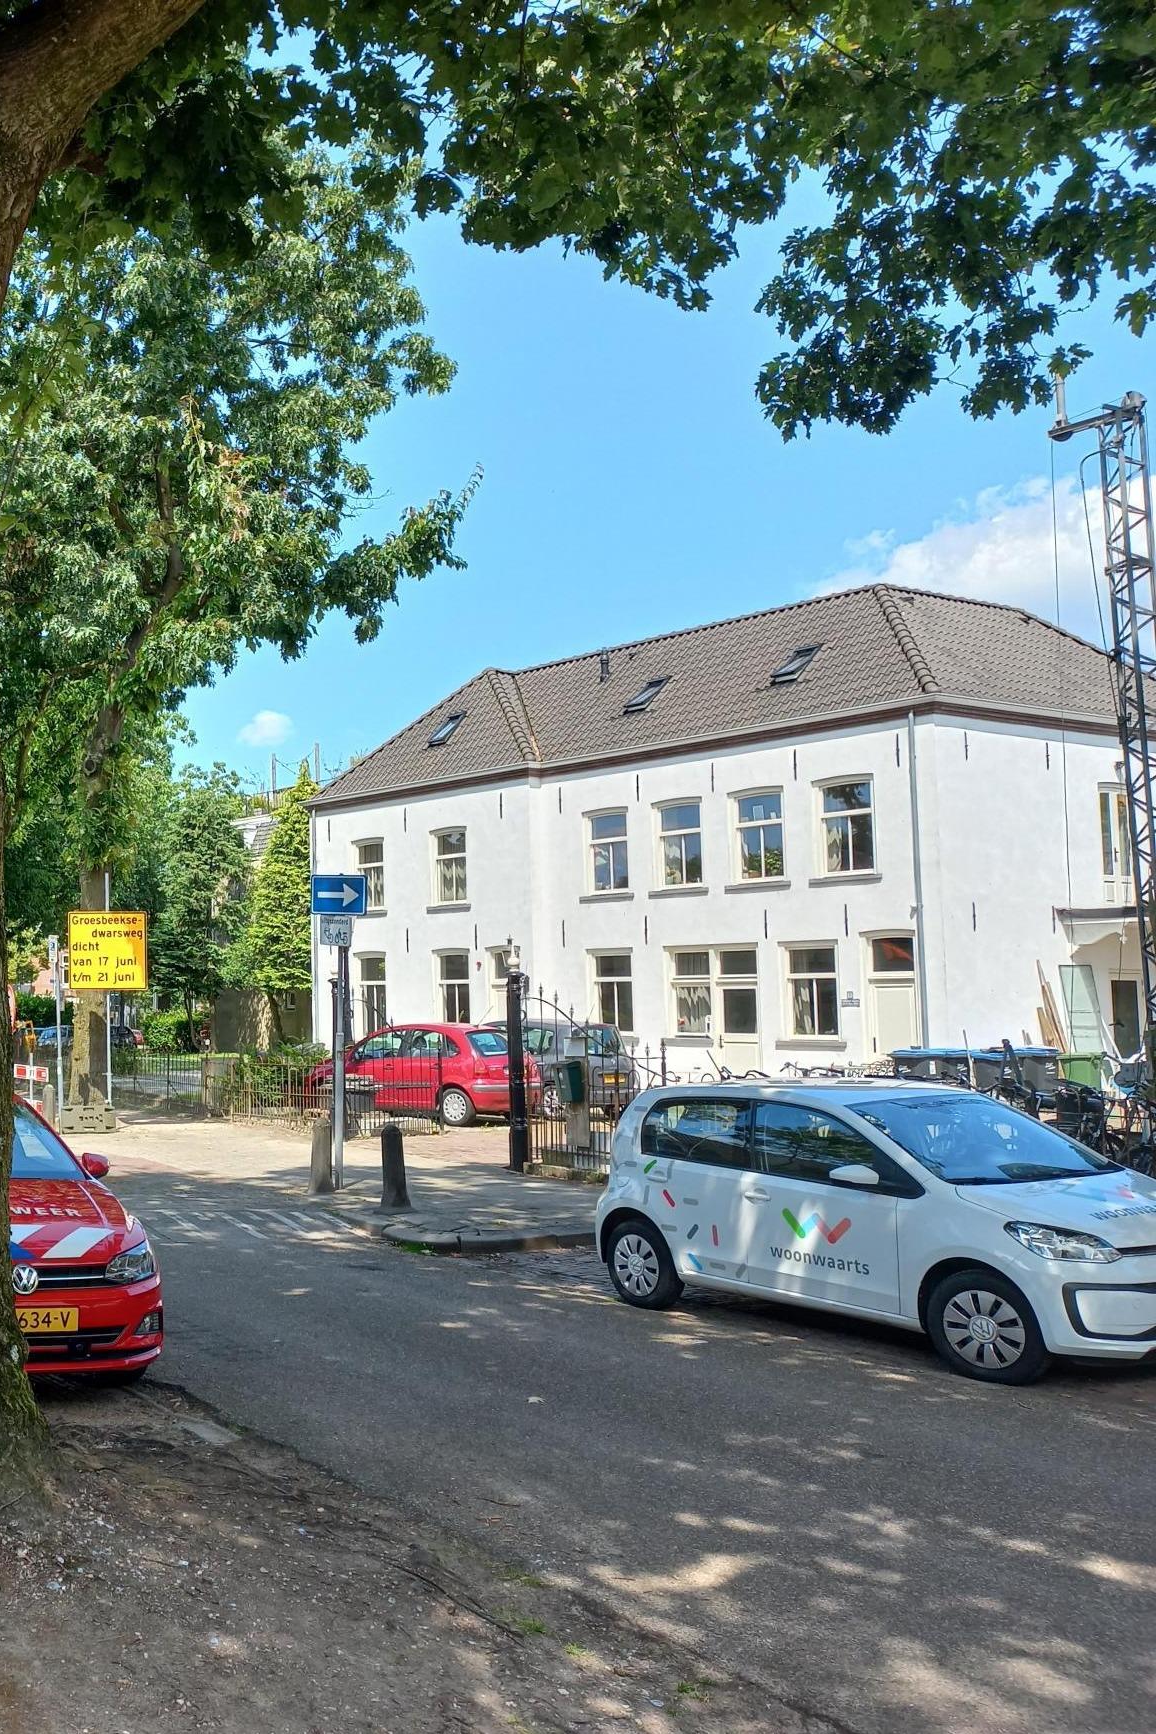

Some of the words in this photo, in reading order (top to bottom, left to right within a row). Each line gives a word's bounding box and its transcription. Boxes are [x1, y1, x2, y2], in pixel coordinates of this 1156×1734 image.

[71, 915, 143, 925] Groesbeekse-
[91, 928, 143, 940] dwarsweg
[72, 941, 100, 951] dicht
[72, 958, 92, 966] van
[98, 956, 109, 966] 17
[115, 956, 137, 969] juni
[72, 972, 92, 983] t/m
[97, 972, 109, 982] 21
[113, 971, 135, 985] juni
[9, 1206, 82, 1217] WEER
[770, 1246, 870, 1275] woonwaarts
[18, 1311, 71, 1329] 634-V
